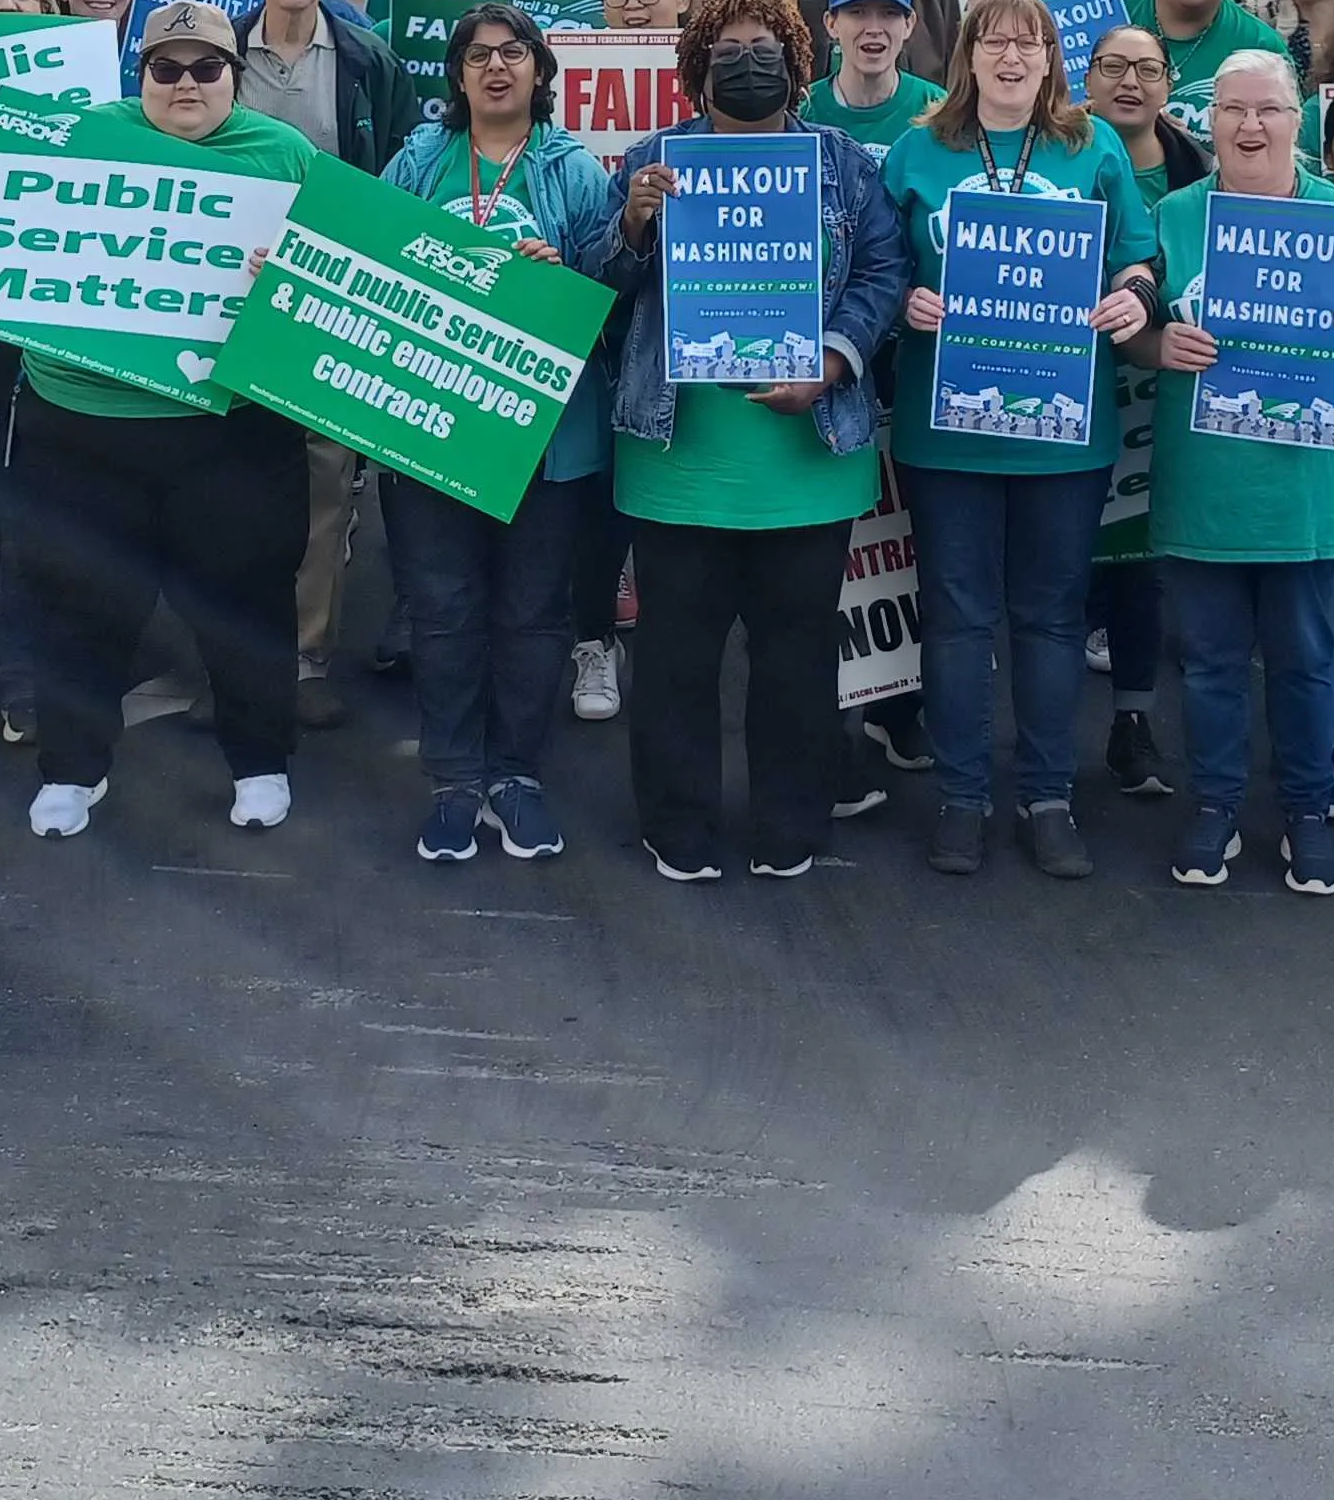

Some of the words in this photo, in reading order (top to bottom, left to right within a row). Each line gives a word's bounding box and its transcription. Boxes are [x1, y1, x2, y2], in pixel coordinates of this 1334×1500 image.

[544, 3, 559, 14] 28
[1063, 31, 1090, 49] OR
[564, 68, 694, 131] FAIR
[3, 169, 235, 220] Public
[673, 166, 810, 196] WALKOUT
[717, 206, 765, 228] FOR
[670, 241, 813, 263] WASHINGTON
[955, 221, 1094, 260] WALKOUT
[402, 237, 500, 290] AFSCME
[671, 282, 702, 292] FAIR
[706, 281, 774, 292] CONTRACT
[779, 281, 813, 291] NOW!
[997, 267, 1044, 289] FOR
[1256, 268, 1302, 294] FOR
[275, 228, 352, 286] Fund
[347, 266, 444, 332] public
[444, 312, 573, 394] services
[947, 293, 1090, 327] WASHINGTON
[270, 282, 294, 313] &
[294, 295, 392, 357] public
[392, 339, 538, 427] employee
[945, 333, 975, 345] FAIR
[980, 336, 1050, 352] CONTRACT
[1052, 343, 1089, 356] NOW!
[1239, 341, 1307, 357] CONTRACT
[313, 353, 456, 440] contracts
